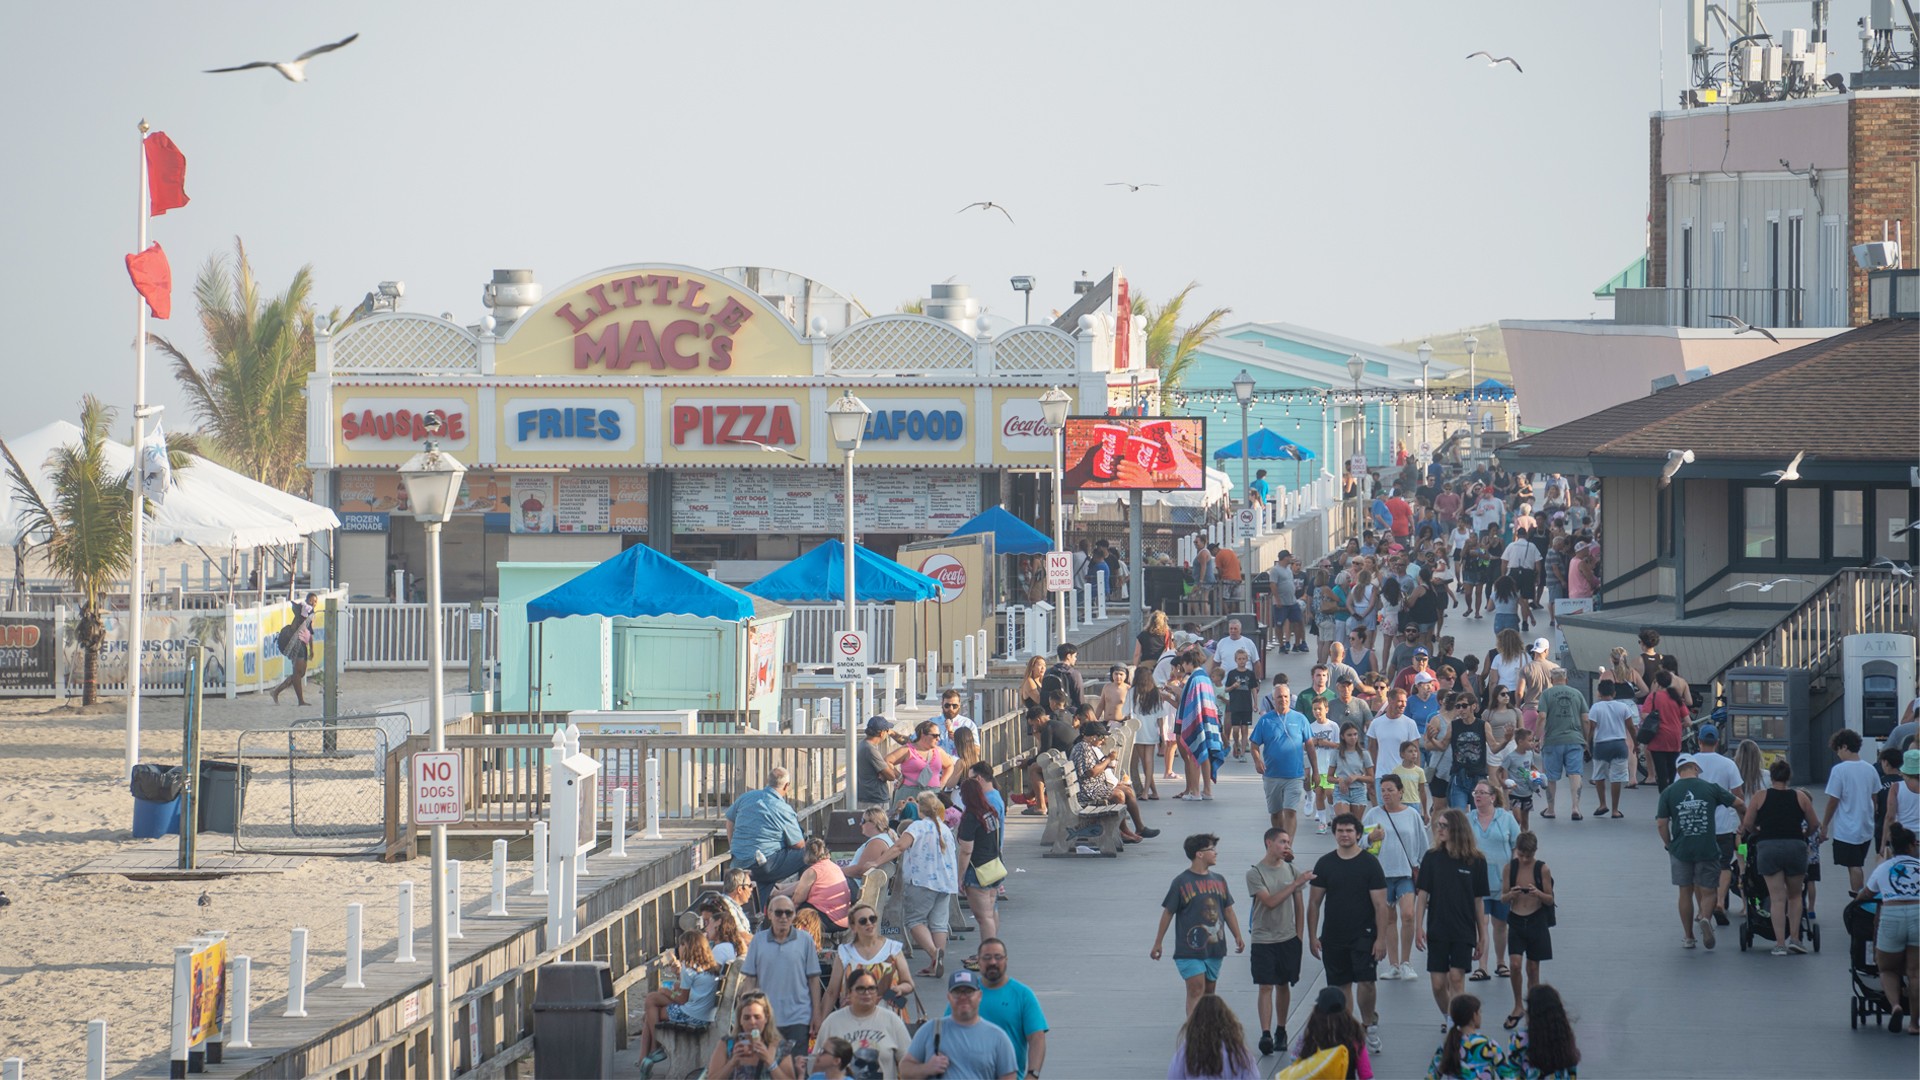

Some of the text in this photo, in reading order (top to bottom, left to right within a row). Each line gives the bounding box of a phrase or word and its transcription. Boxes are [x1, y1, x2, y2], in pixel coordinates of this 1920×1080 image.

[555, 274, 754, 334] LITTLE
[341, 408, 466, 441] SAUSAGE
[517, 407, 622, 442] FRIES
[673, 406, 796, 445] PIZZA
[688, 504, 709, 512] TACOS
[351, 515, 380, 523] FROZEN
[342, 522, 383, 531] LEMONADE
[612, 524, 648, 533] LEMONAD
[1051, 556, 1068, 568] NO
[1049, 578, 1072, 586] ALLOWED
[1863, 640, 1898, 651] ATM
[422, 762, 452, 781] NO
[420, 785, 455, 798] DOGS
[418, 802, 458, 815] ALLOWED
[1179, 881, 1196, 903] LIL
